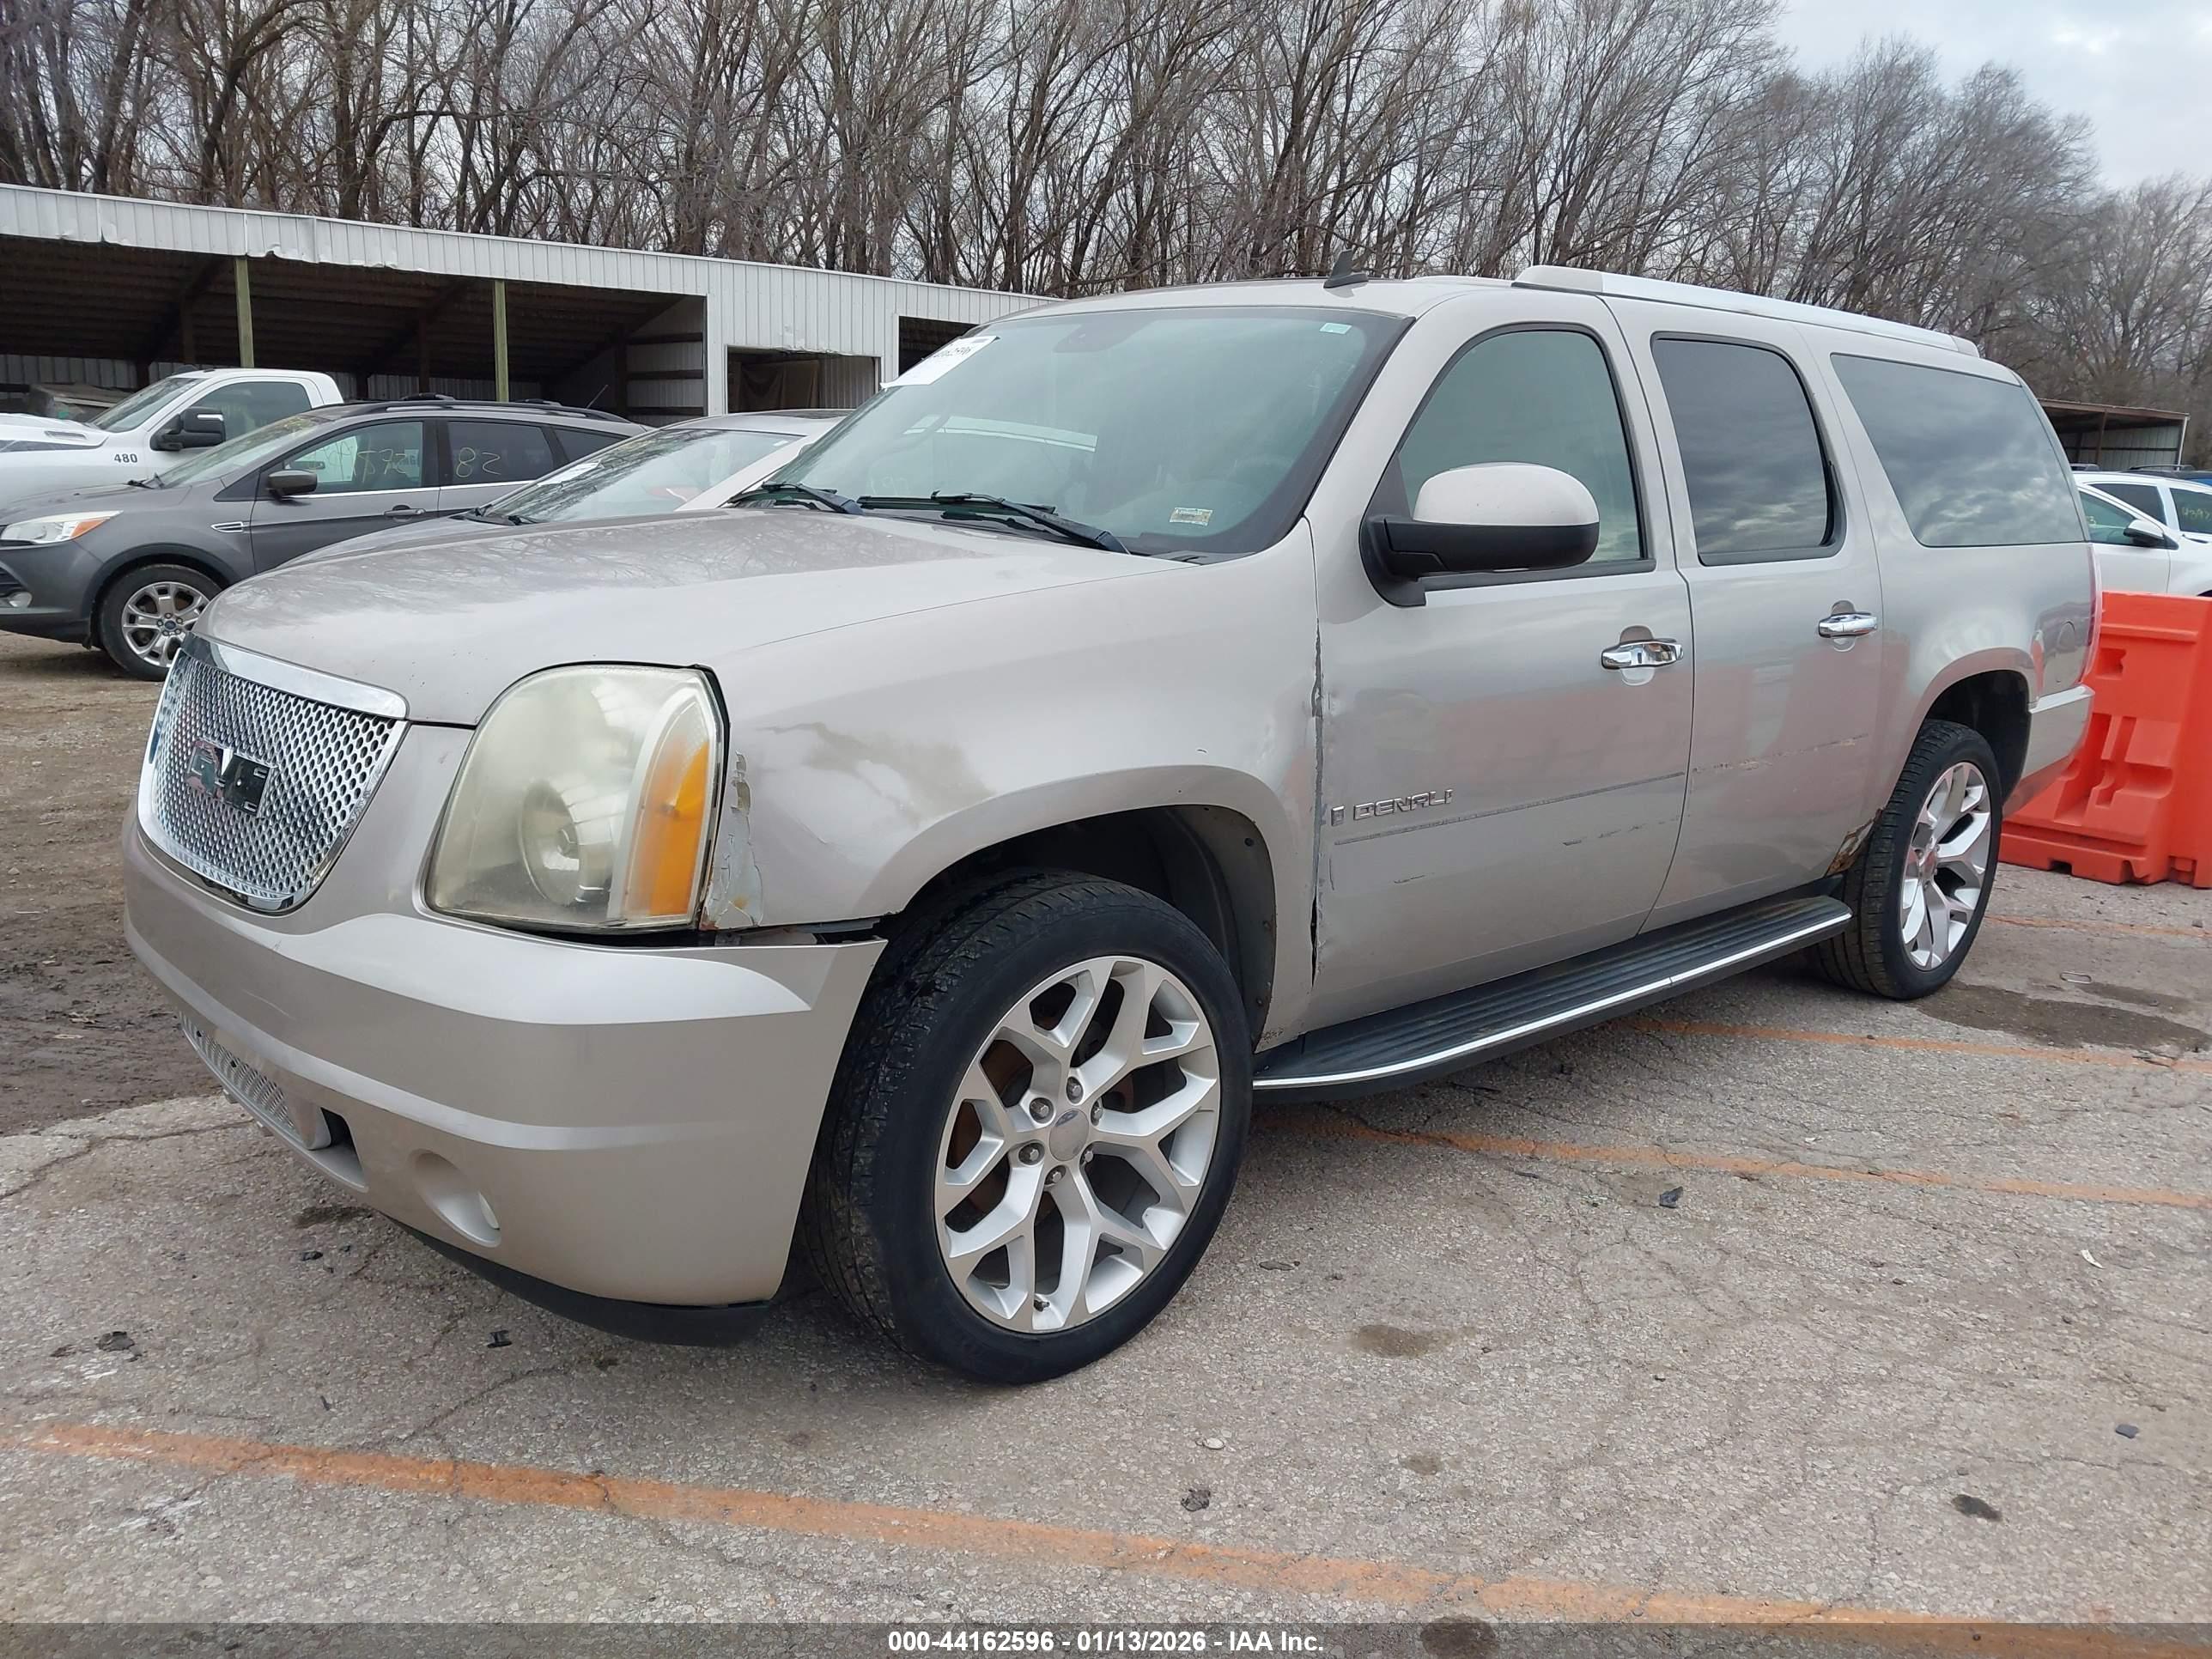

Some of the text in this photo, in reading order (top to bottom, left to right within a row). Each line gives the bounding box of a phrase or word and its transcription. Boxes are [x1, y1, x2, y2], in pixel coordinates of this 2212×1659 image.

[113, 453, 138, 463] 480
[456, 447, 501, 477] 82
[1352, 788, 1453, 821] DENALI
